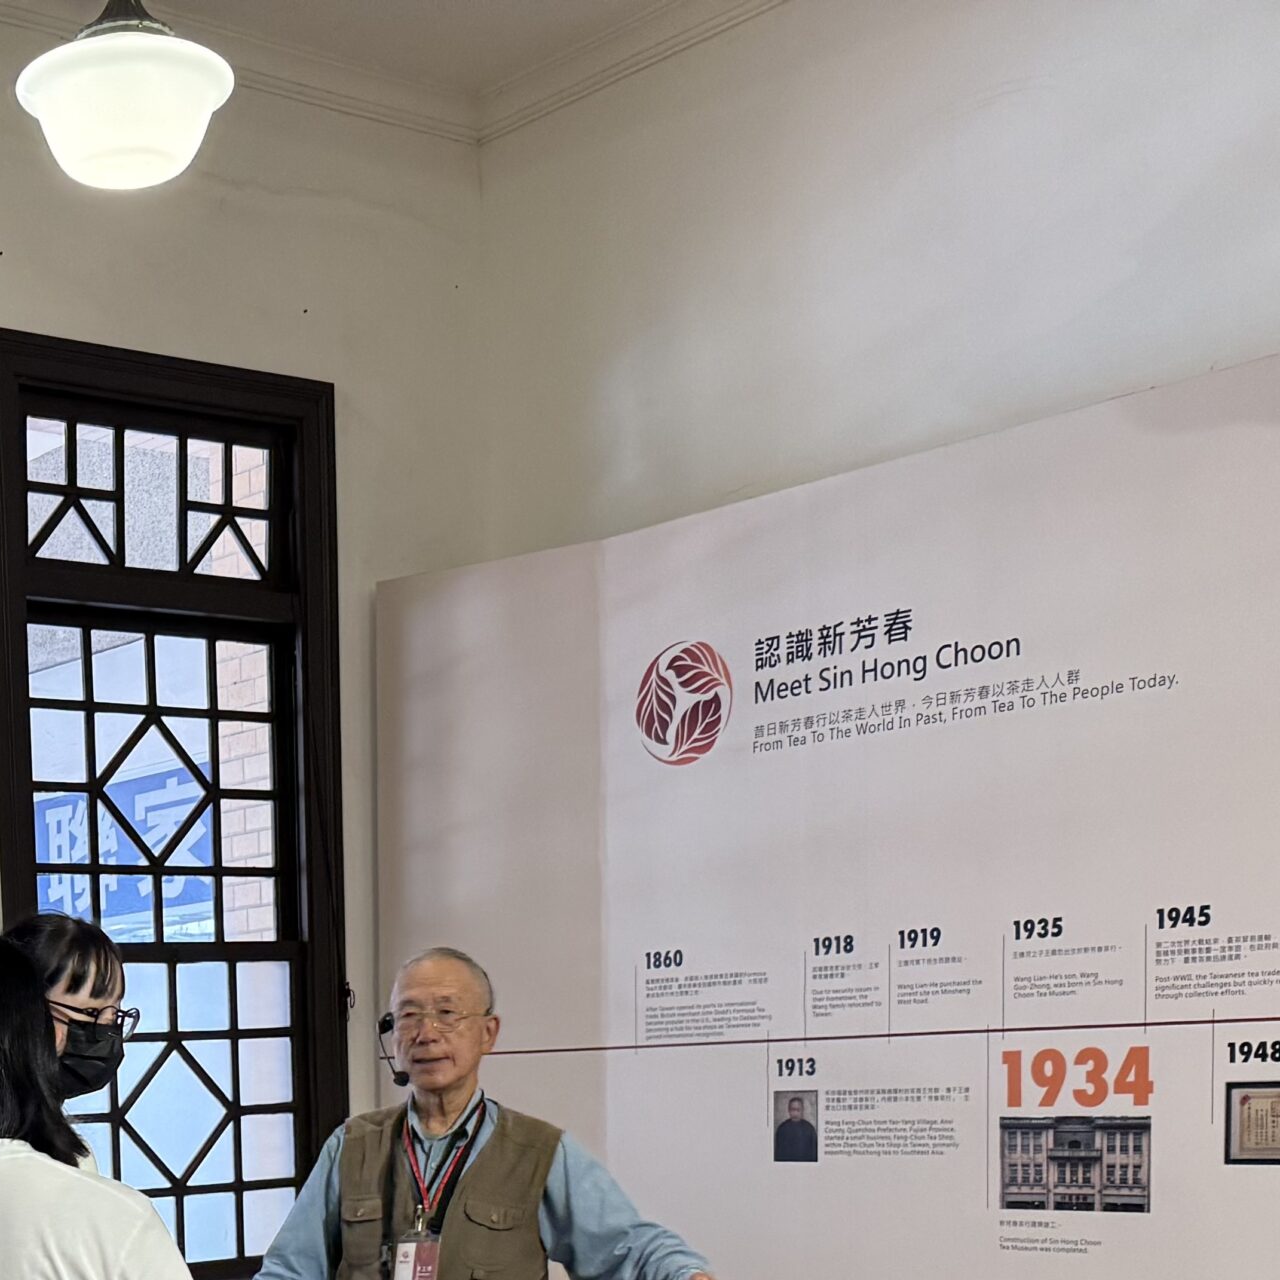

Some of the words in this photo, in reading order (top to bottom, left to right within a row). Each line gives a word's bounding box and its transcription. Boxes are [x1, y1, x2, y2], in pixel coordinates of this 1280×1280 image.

[754, 608, 912, 671] 認識新芳春
[754, 674, 812, 704] Meet
[819, 665, 852, 691] Sin
[862, 655, 927, 681] Hong
[936, 635, 1021, 669] Choon
[753, 739, 783, 754] From
[787, 734, 807, 747] Tea
[811, 731, 824, 744] To
[829, 727, 852, 740] The
[855, 719, 894, 736] World
[898, 716, 911, 729] In
[916, 712, 947, 726] Past,
[952, 705, 986, 721] From
[992, 700, 1014, 714] Tea
[1020, 695, 1036, 709] To
[1041, 692, 1067, 706] The
[1072, 681, 1124, 700] People
[1129, 673, 1179, 691] Today.
[1156, 905, 1211, 929] 1945
[898, 927, 942, 949] 1919
[1013, 917, 1063, 940] 1935
[814, 935, 854, 956] 1918
[645, 950, 683, 970] 1860
[1155, 983, 1192, 992] significant
[1193, 982, 1231, 990] challenges
[1247, 979, 1273, 987] quickly
[1209, 972, 1245, 980] Taiwanese
[1155, 992, 1183, 1000] through
[1185, 990, 1219, 998] collective
[1228, 1041, 1280, 1063] 1948
[777, 1057, 816, 1077] 1913
[1002, 1046, 1154, 1107] 1934
